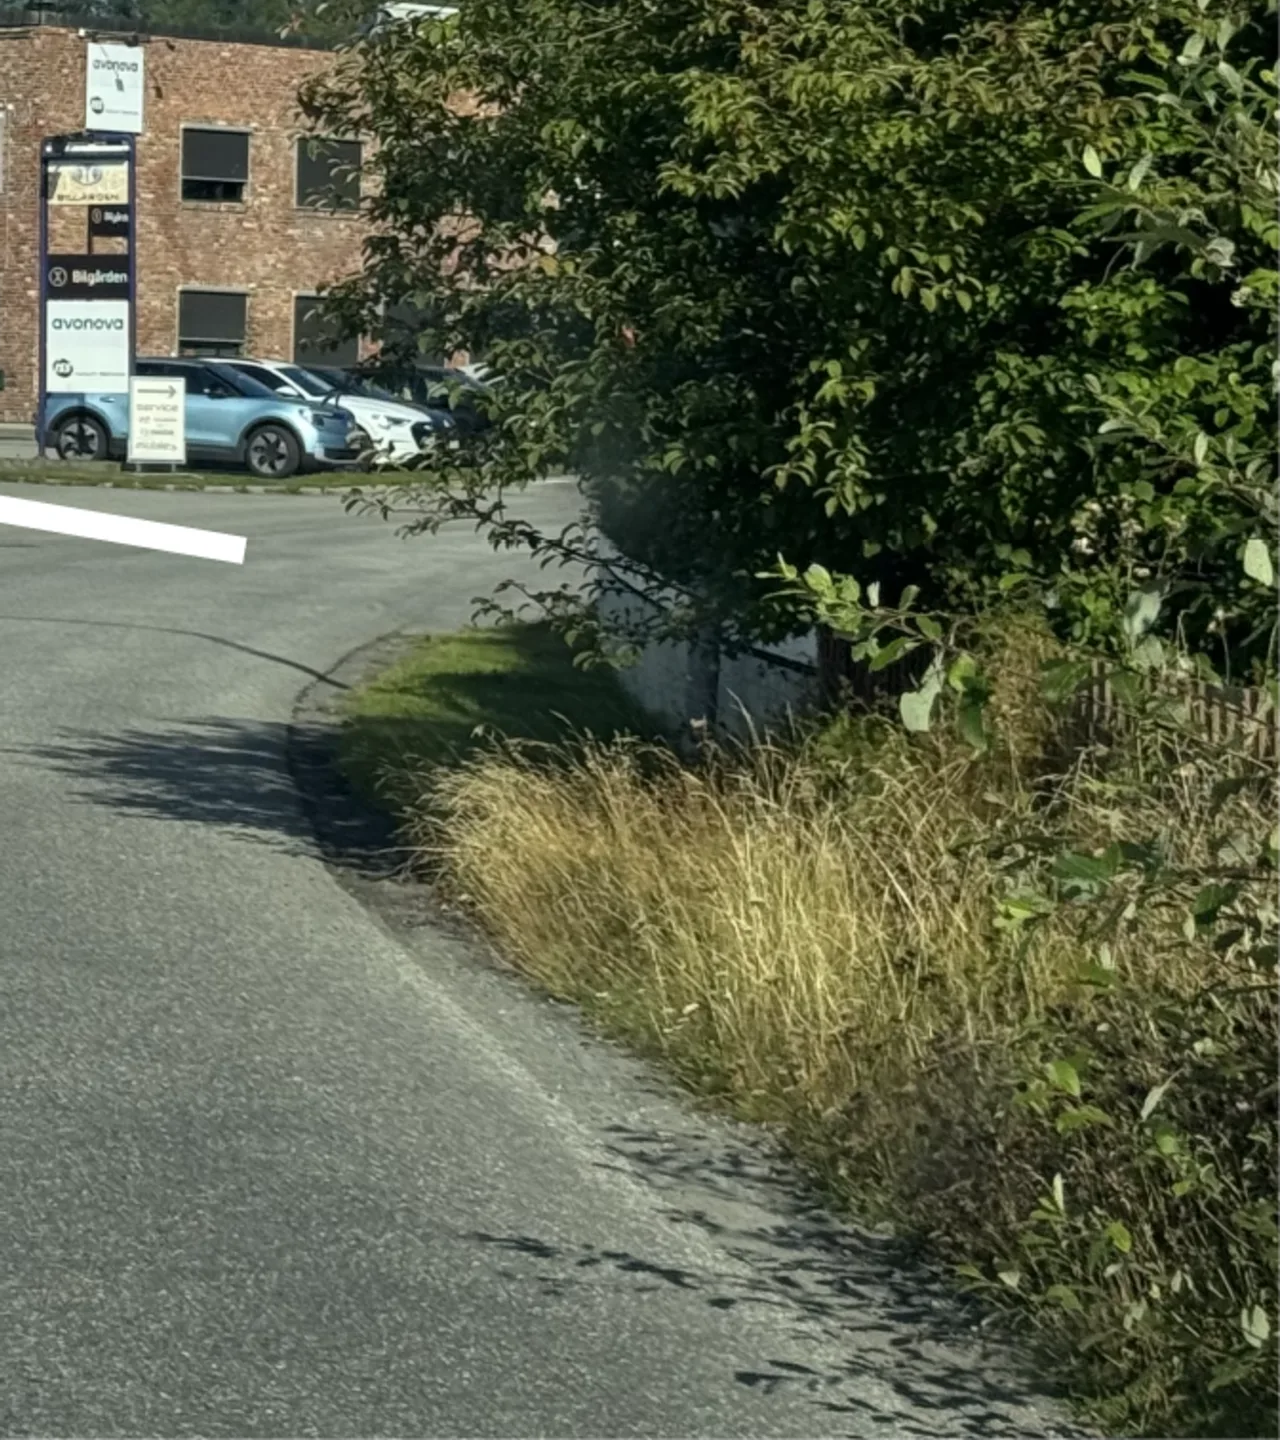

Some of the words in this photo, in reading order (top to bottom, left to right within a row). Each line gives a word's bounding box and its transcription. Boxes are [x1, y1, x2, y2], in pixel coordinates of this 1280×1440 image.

[92, 59, 139, 72] avonova
[72, 269, 128, 286] Bilgården
[51, 318, 124, 330] avonova
